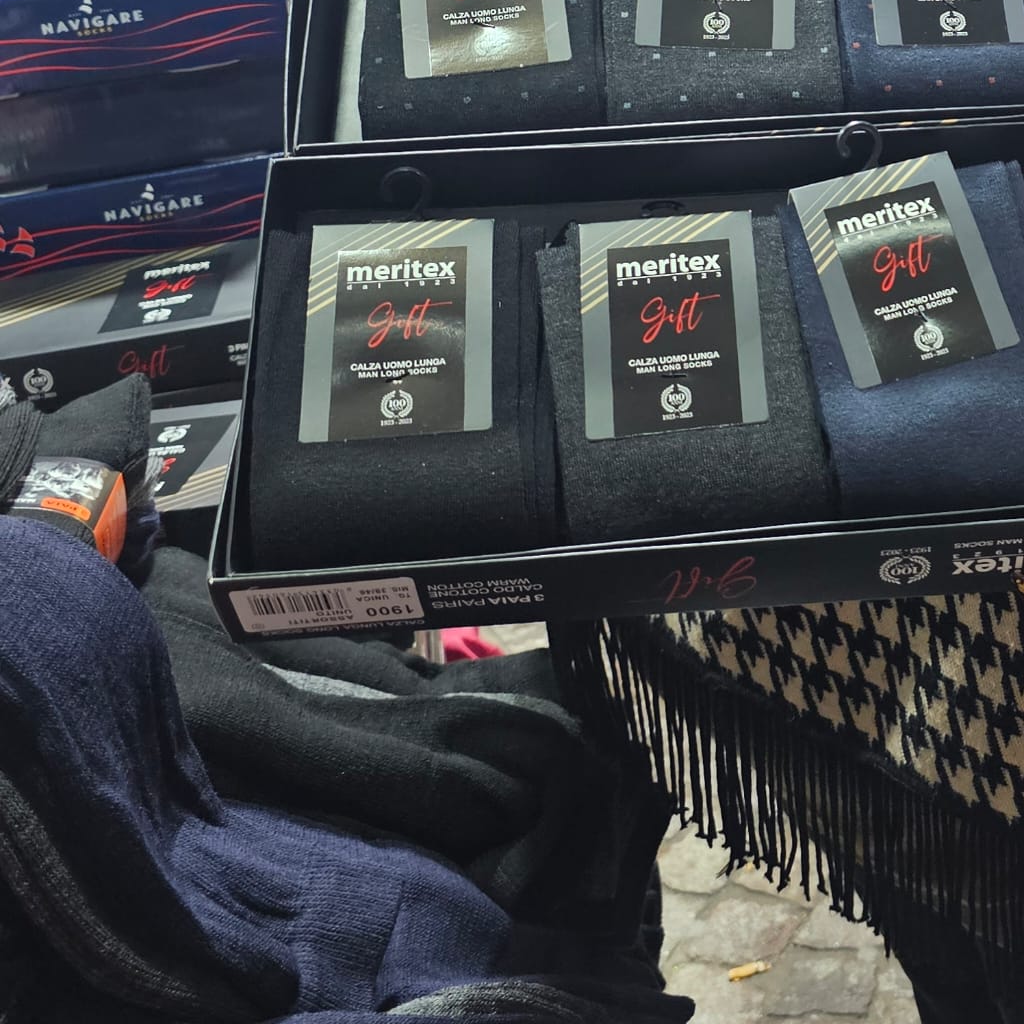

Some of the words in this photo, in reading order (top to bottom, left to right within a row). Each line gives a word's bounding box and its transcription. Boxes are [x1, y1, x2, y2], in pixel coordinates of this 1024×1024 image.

[443, 12, 470, 20] CALZA
[471, 8, 496, 17] UOMO
[497, 5, 526, 14] LUNGA
[41, 9, 145, 36] NAVIGARE
[450, 18, 468, 26] MAN
[104, 194, 205, 223] NAVIGARE
[836, 196, 936, 235] meritex
[616, 252, 720, 278] meritex
[873, 233, 943, 292] Gift
[346, 258, 456, 282] meritex
[874, 303, 902, 316] CALZA
[902, 295, 928, 308] UOMO
[928, 287, 958, 301] LUNGA
[884, 310, 902, 321] MAN
[927, 296, 953, 310] SOCKS
[367, 298, 453, 348] Gift
[640, 292, 721, 344] Gift
[350, 362, 382, 372] CALZA
[383, 360, 413, 370] UOMO
[414, 357, 446, 367] LUNGA
[628, 357, 658, 367] CALZA
[659, 354, 687, 365] UOMO
[688, 350, 720, 361] LUNGA
[636, 366, 656, 374] MAN
[657, 363, 682, 372] LONG
[683, 360, 713, 370] SOCKS
[358, 370, 379, 379] MAN
[954, 540, 995, 549] SOCKS
[997, 537, 1023, 545] MAN
[890, 566, 918, 576] 100
[427, 581, 484, 592] COTTON
[487, 578, 531, 587] WARM
[493, 583, 543, 593] CALDO
[356, 594, 389, 602] UNICA
[428, 587, 490, 598] COTONE
[534, 594, 545, 602] 3
[431, 598, 486, 609] PAIRS
[488, 594, 531, 605] PAIA
[366, 604, 414, 617] 1900
